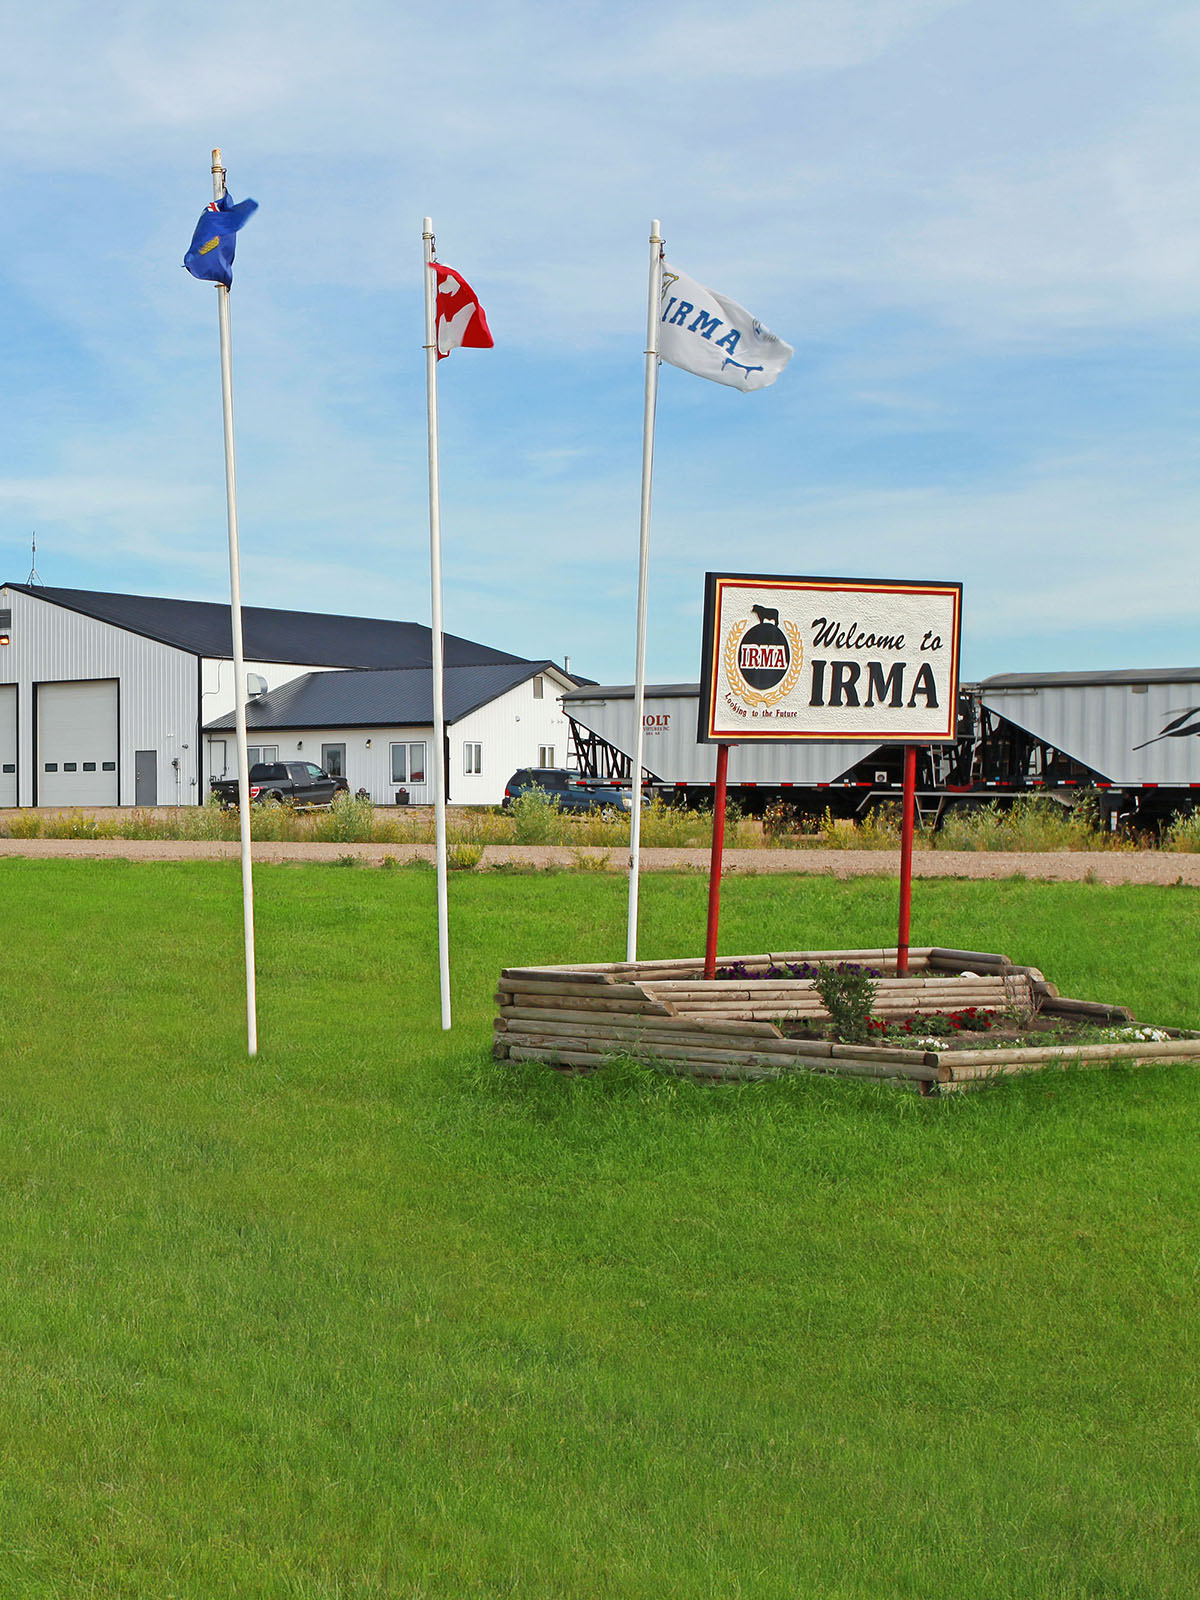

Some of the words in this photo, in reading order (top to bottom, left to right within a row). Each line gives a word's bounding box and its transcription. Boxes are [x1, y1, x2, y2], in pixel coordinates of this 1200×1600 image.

[661, 297, 742, 356] IRMA
[810, 617, 906, 651] Welcome
[919, 630, 944, 652] to
[741, 647, 786, 668] IRMA
[808, 659, 940, 709] IRMA
[725, 692, 747, 717] Looking
[762, 709, 773, 717] the
[776, 709, 798, 717] Future
